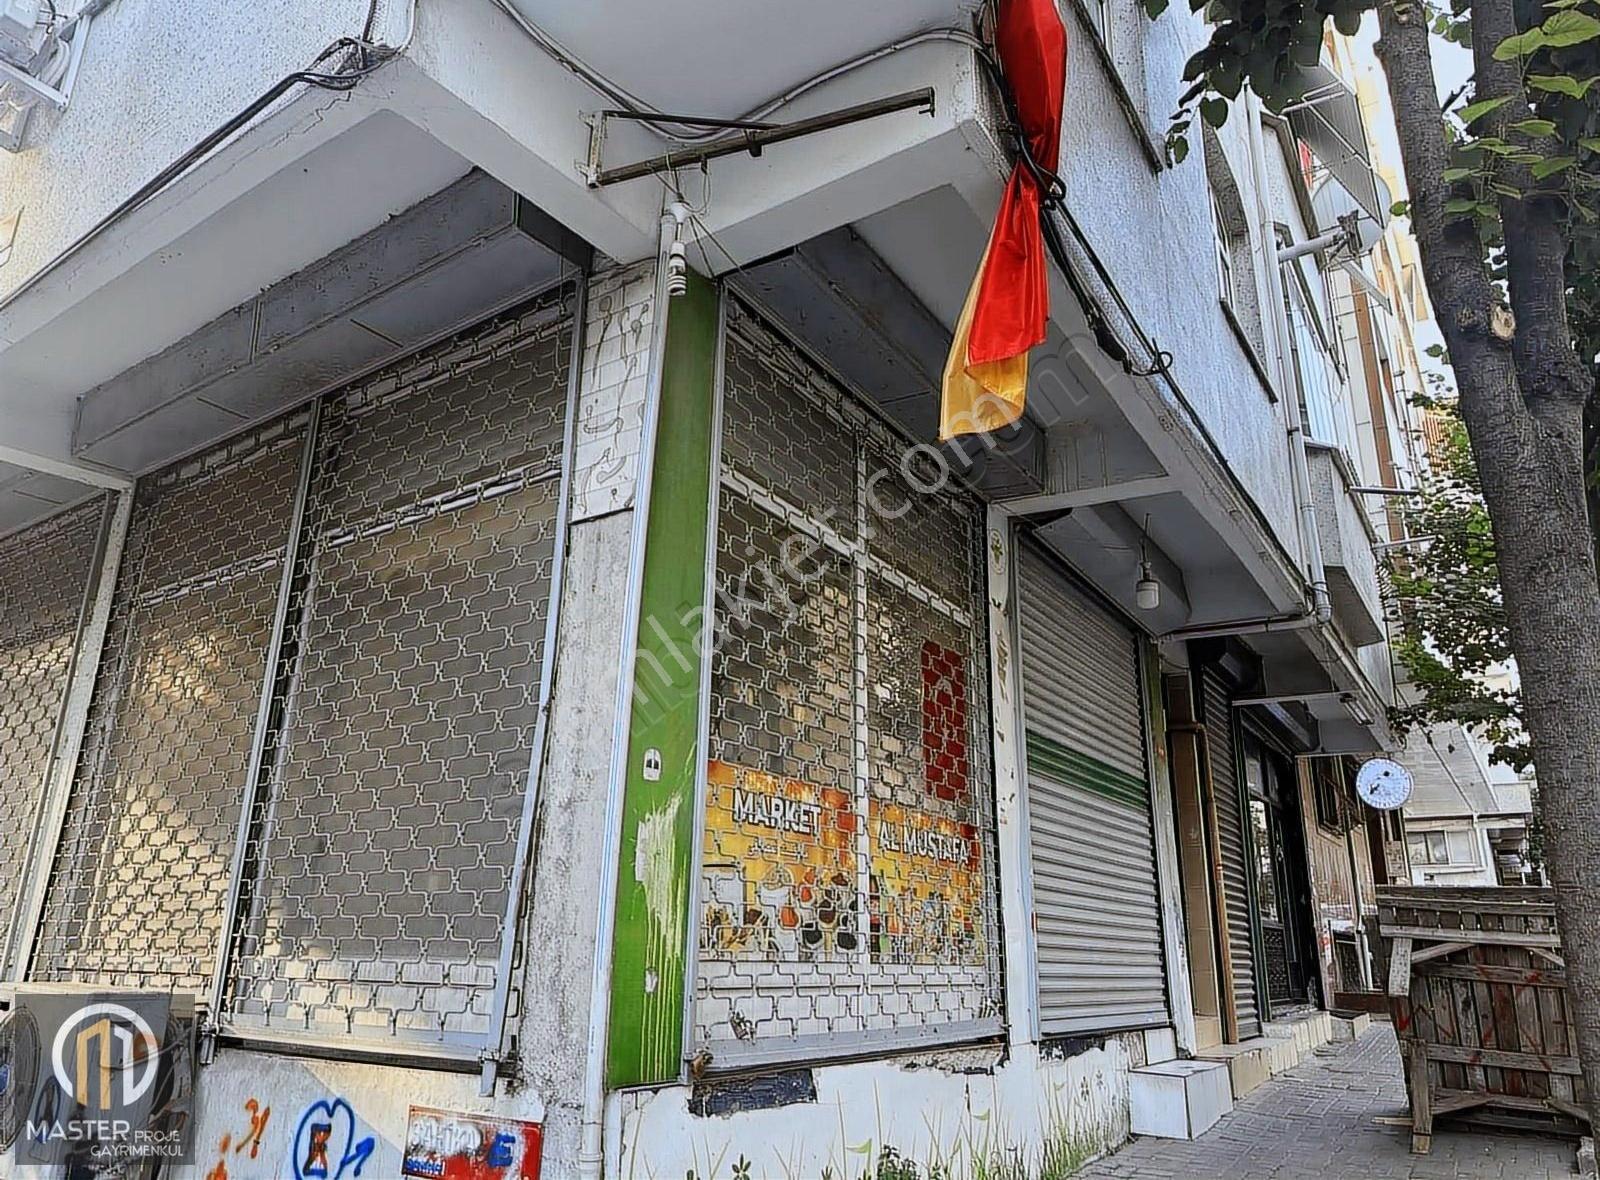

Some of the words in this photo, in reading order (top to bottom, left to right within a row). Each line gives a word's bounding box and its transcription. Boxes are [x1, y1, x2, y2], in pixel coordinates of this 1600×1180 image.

[733, 787, 822, 836] MARKET
[880, 821, 900, 851] AL
[903, 824, 969, 865] MUSTAFA
